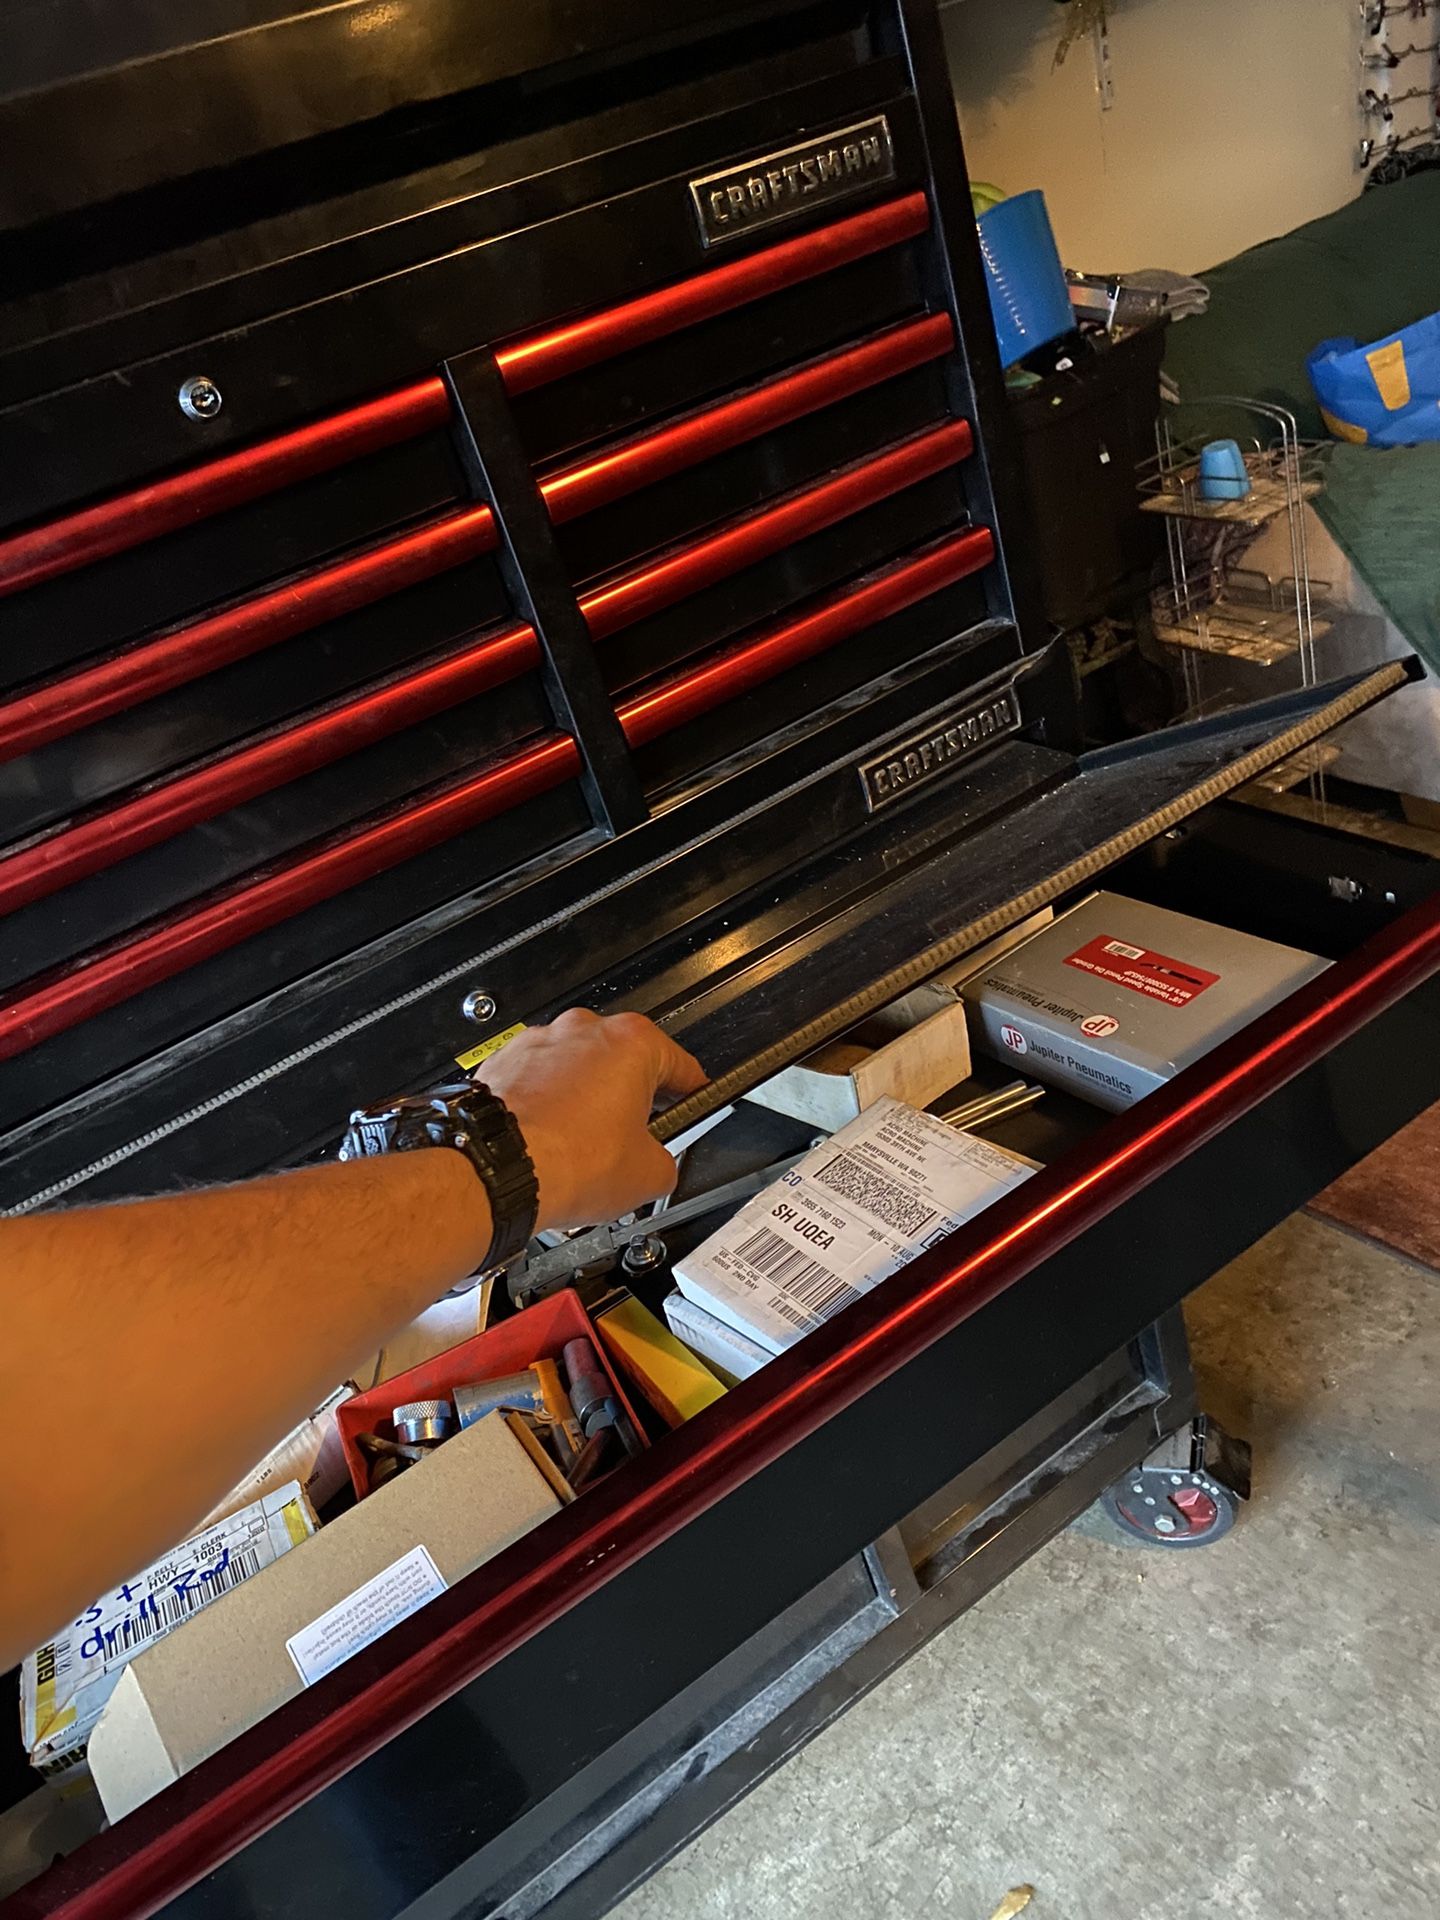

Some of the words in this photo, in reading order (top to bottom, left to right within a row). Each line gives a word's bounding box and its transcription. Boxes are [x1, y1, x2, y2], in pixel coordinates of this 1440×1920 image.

[709, 135, 882, 223] CRAFTSMAN
[873, 699, 1011, 793] CRAFTSMAN
[983, 978, 1043, 1008] Pneumatics
[1123, 977, 1144, 989] Speed
[1042, 1002, 1084, 1023] Jupiter
[1084, 1019, 1115, 1033] JP
[1005, 1032, 1023, 1049] JP
[1029, 1040, 1065, 1064] Jupiter
[1067, 1056, 1132, 1094] Pneumatics
[896, 1135, 922, 1152] MACHINE
[904, 1148, 918, 1158] AVE
[861, 1141, 899, 1165] MARYSVILLE
[897, 1161, 910, 1172] WA
[771, 1203, 798, 1224] SH
[793, 1217, 835, 1250] UQEA
[898, 1248, 915, 1261] AUG
[732, 1270, 746, 1282] 2ND
[744, 1279, 759, 1291] DAY
[200, 1532, 227, 1550] CLERK
[148, 1567, 179, 1590] HWY
[193, 1542, 223, 1564] 1003
[80, 1593, 156, 1659] drill
